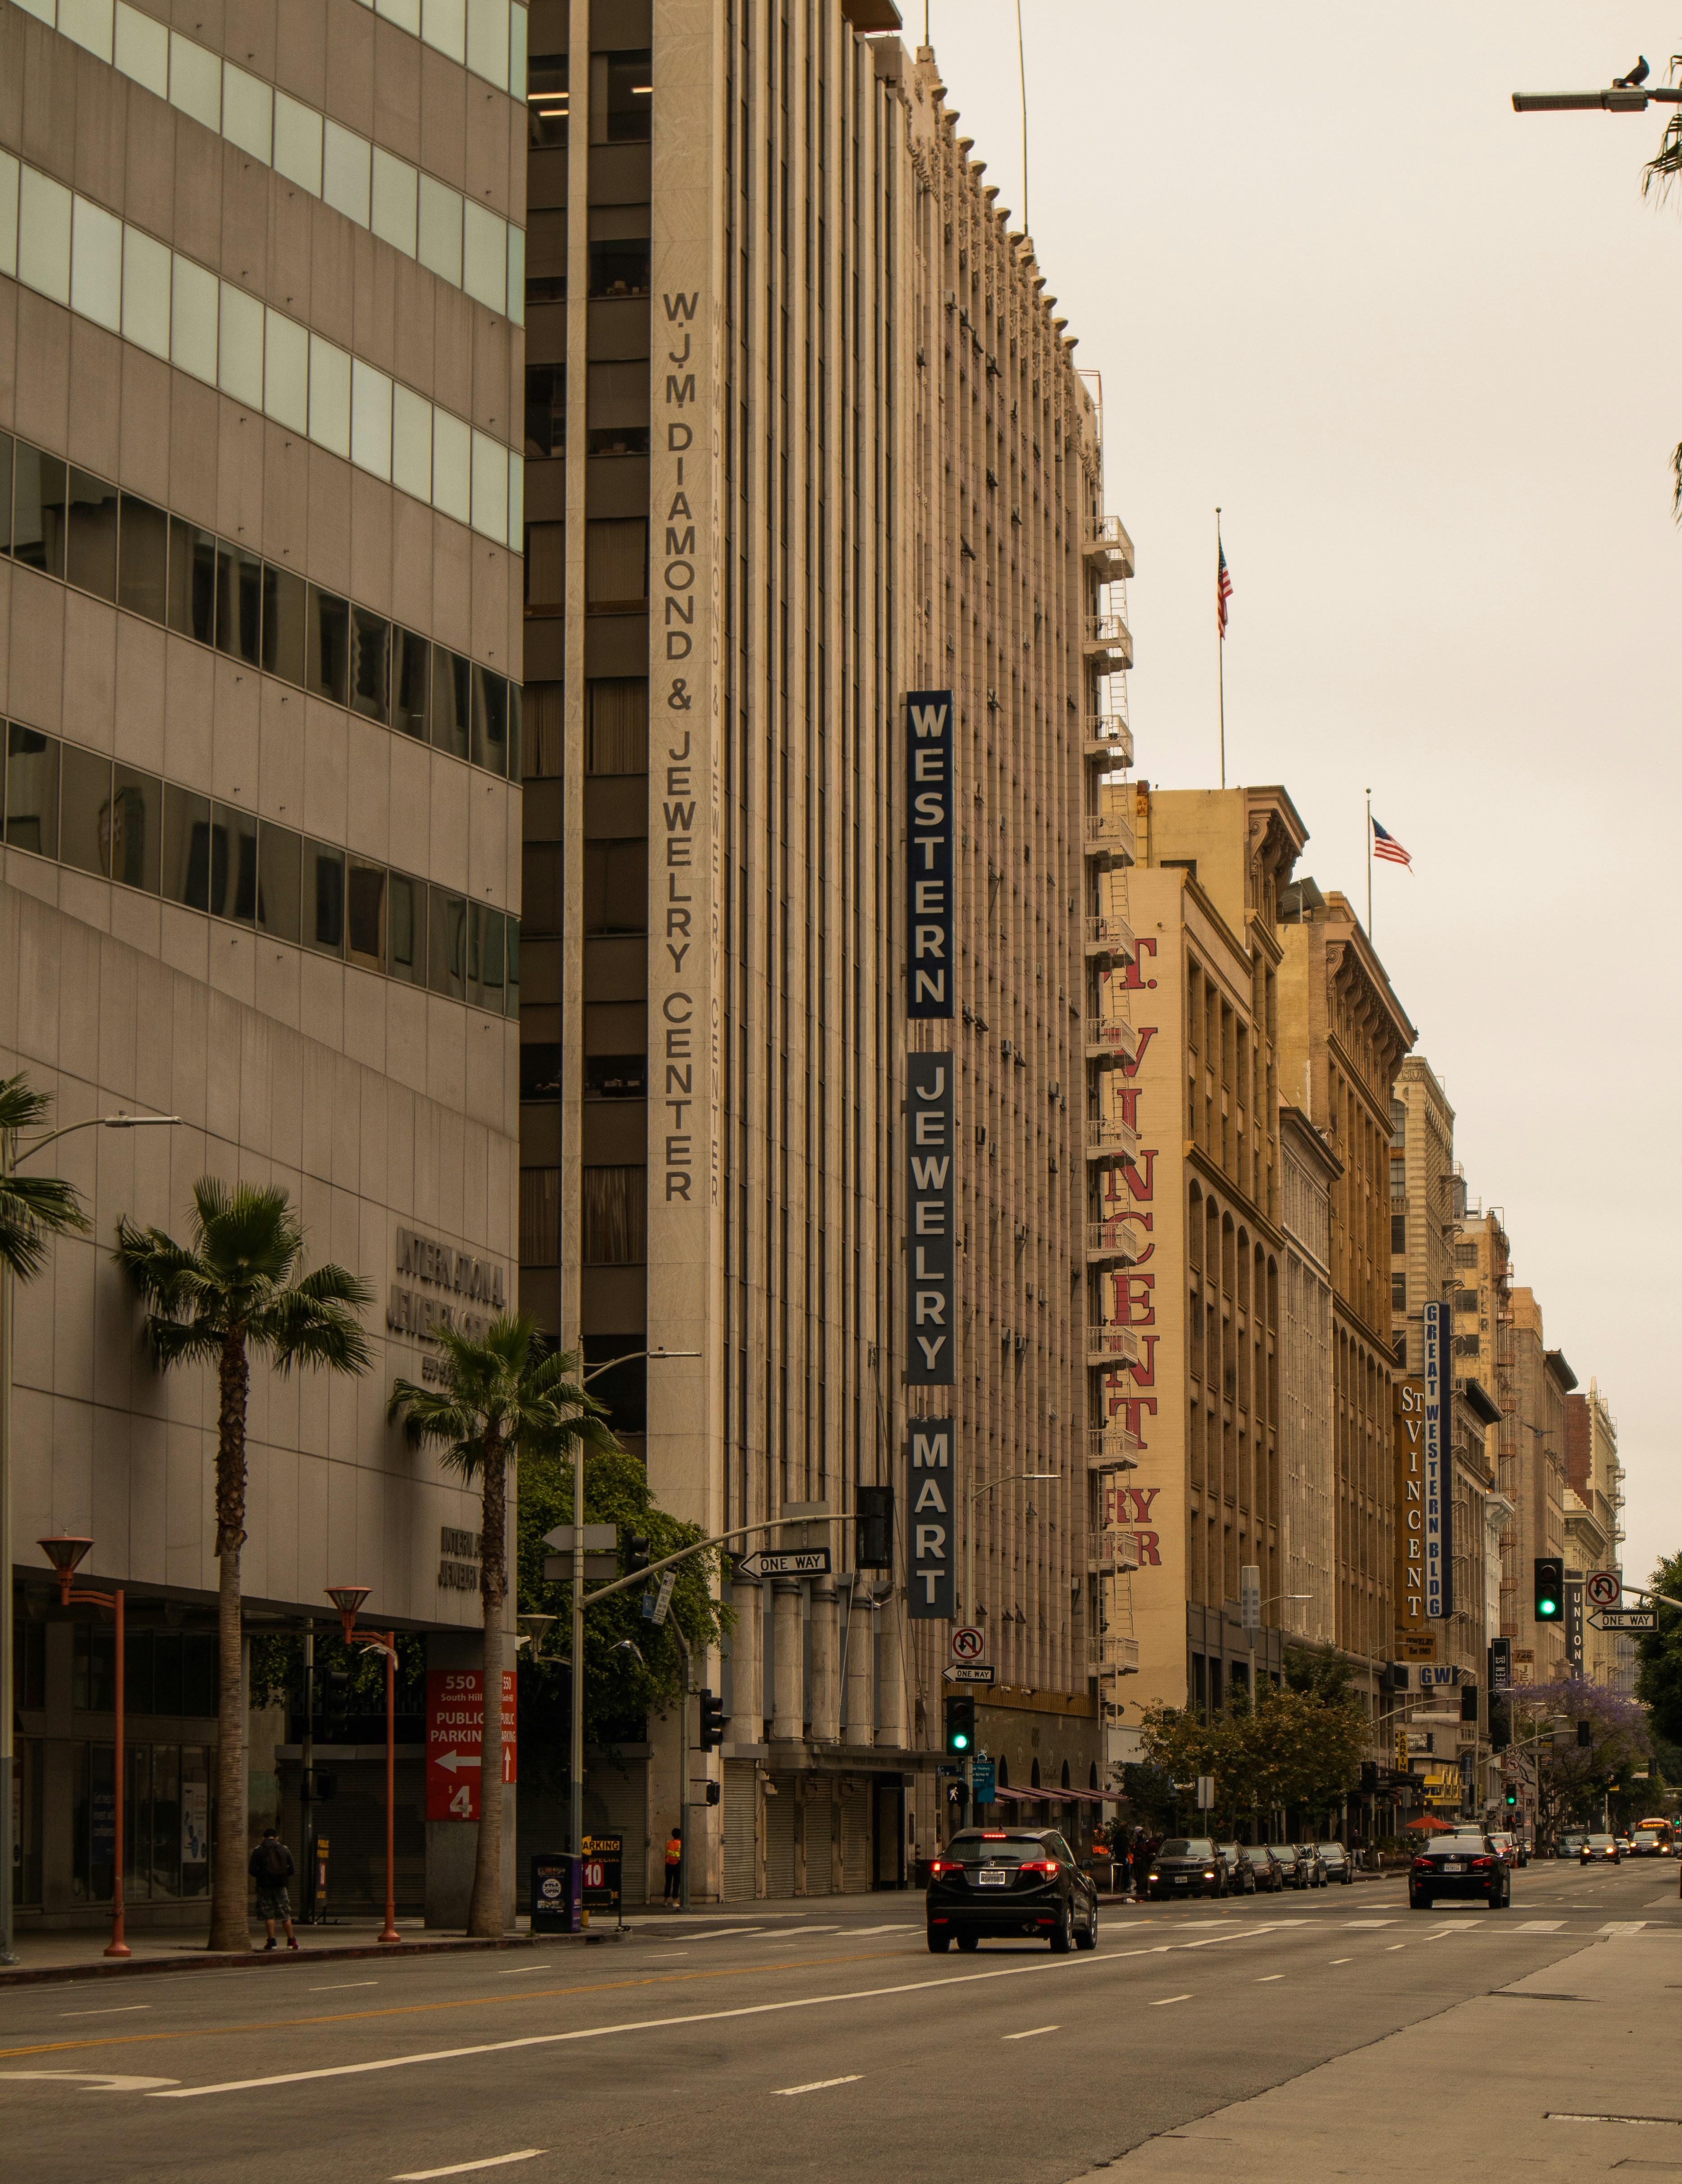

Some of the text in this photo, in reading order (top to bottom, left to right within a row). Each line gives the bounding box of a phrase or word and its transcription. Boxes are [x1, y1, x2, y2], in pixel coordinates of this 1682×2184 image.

[664, 423, 695, 661] DIAMOND
[667, 677, 692, 710] &
[663, 732, 696, 973] JEWELRY
[663, 992, 693, 1201] CENTER
[910, 704, 951, 1605] WESTERN JEWELRY MART
[397, 1226, 507, 1308] INTERNATIONAL
[1426, 1305, 1439, 1614] GREAT WESTERN BLDG
[1405, 1419, 1423, 1616] VINCENT
[761, 1555, 820, 1571] ONE WAY
[1603, 1616, 1650, 1625] ONE WAY
[445, 1676, 476, 1690] 550
[503, 1677, 512, 1691] 550
[1422, 1668, 1451, 1683] GW
[441, 1693, 483, 1702] South Hill
[430, 1730, 482, 1742] PARKIN
[501, 1731, 516, 1743] ARKING
[583, 1841, 619, 1850] ARKING
[585, 1864, 602, 1886] 10
